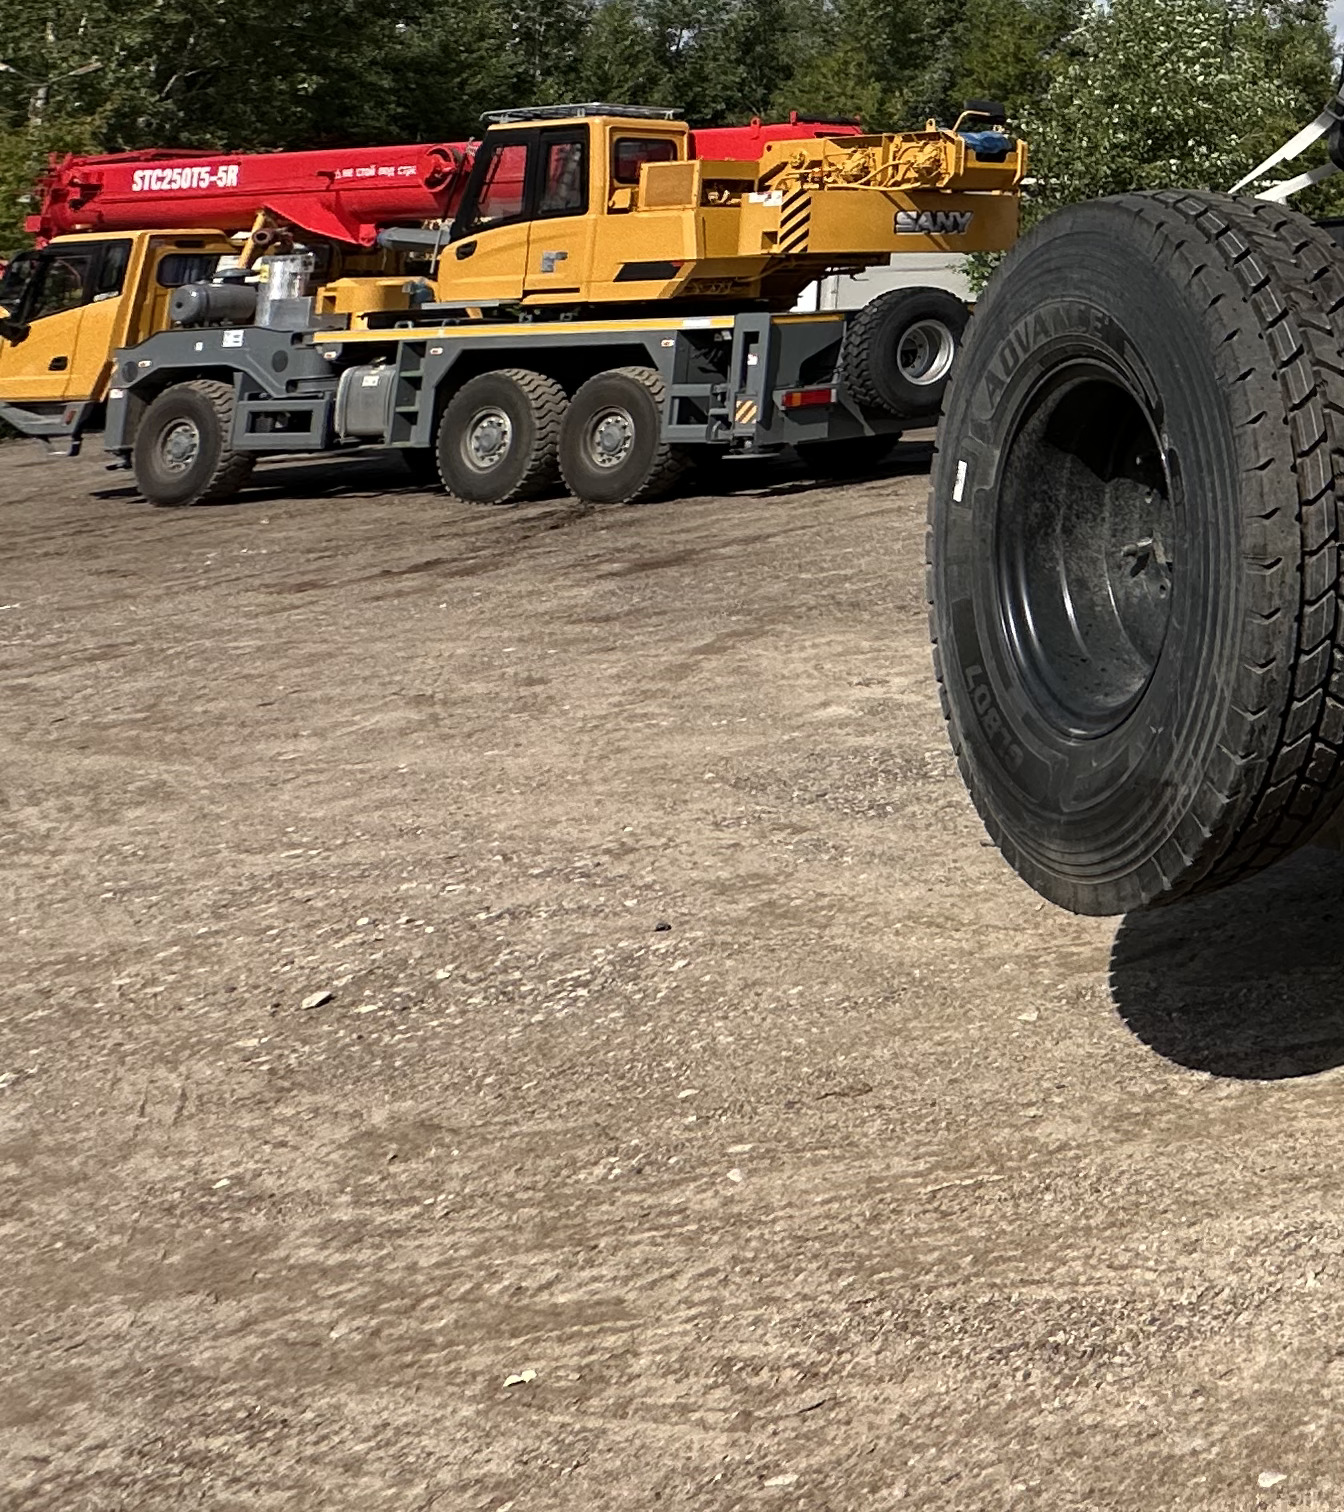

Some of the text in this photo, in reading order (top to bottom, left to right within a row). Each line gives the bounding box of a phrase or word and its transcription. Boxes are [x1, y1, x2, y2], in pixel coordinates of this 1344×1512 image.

[131, 164, 240, 192] STC250T5-5R
[894, 210, 974, 234] SANY
[984, 301, 1104, 411] ADVANCE
